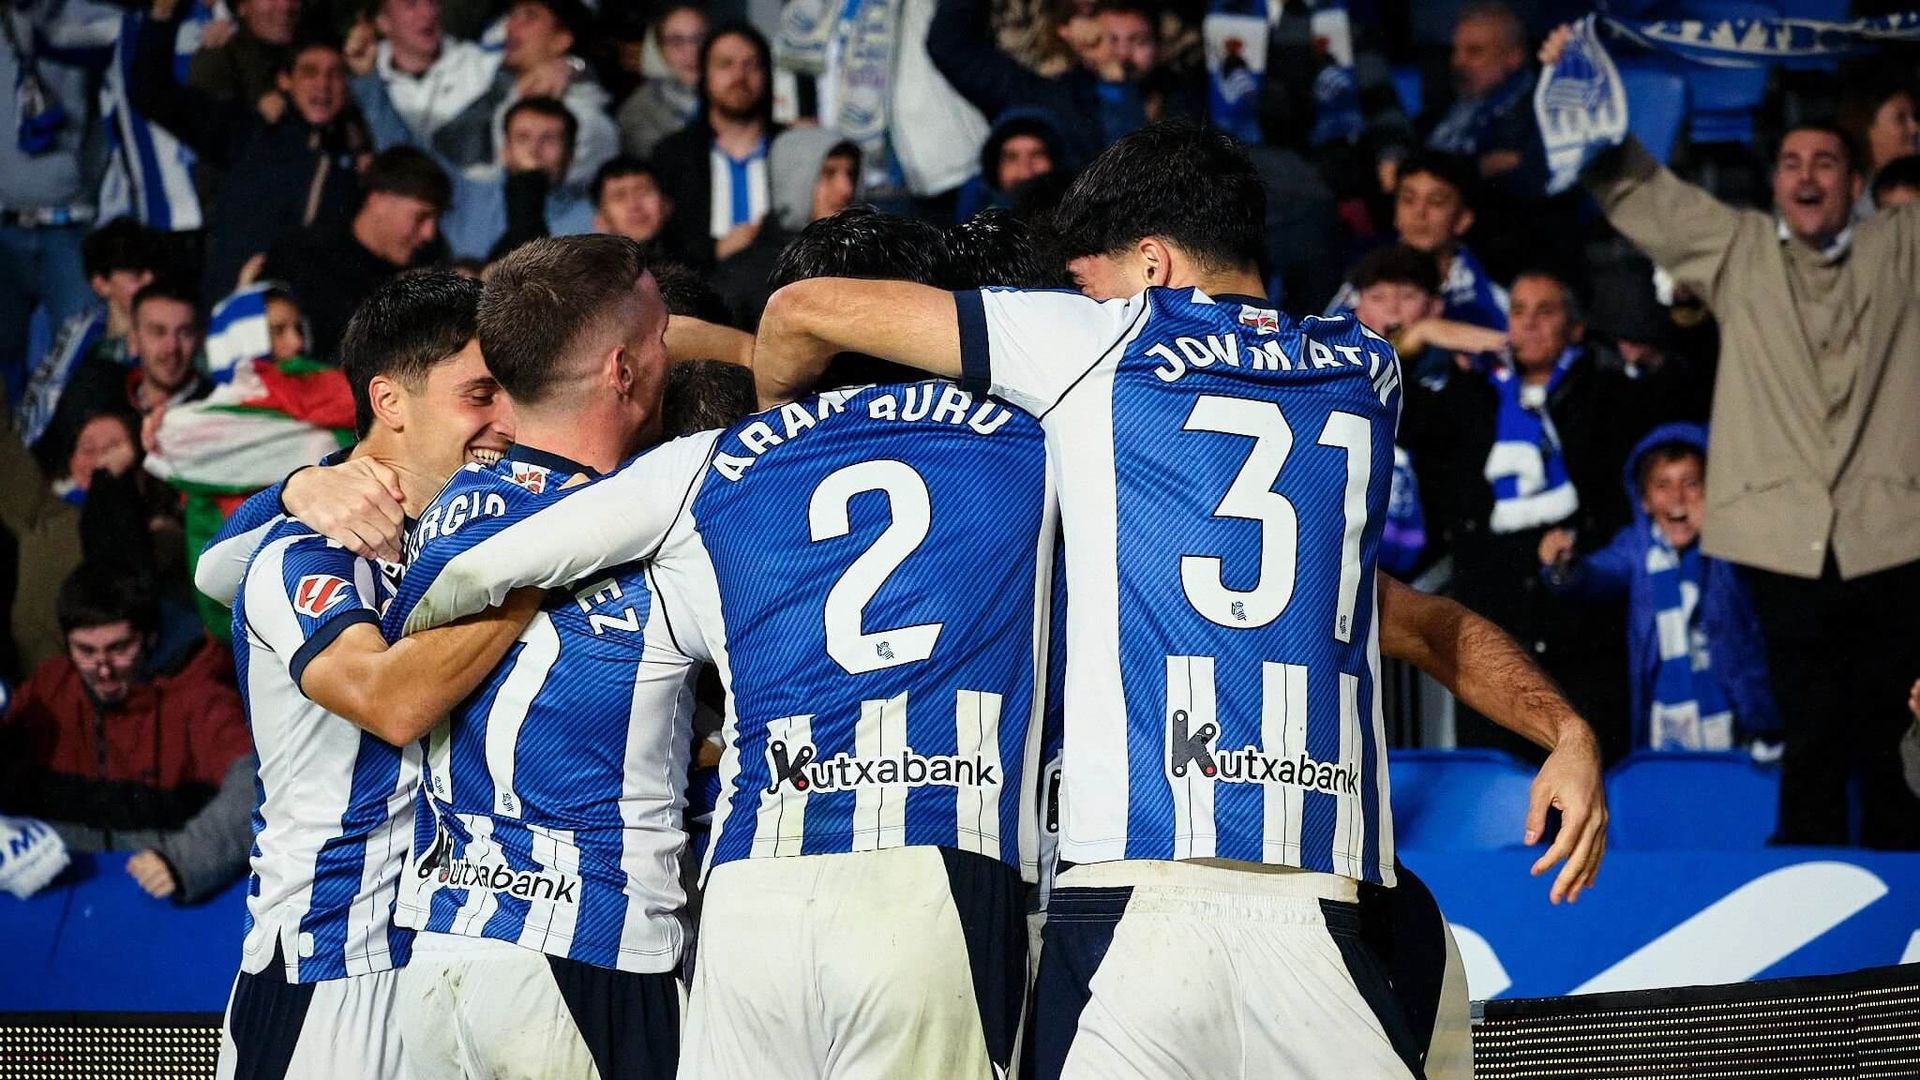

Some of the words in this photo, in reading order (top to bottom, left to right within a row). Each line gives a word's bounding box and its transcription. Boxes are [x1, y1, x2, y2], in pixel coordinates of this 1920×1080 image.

[1144, 333, 1240, 383] JON
[1179, 394, 1373, 645] 31
[807, 459, 945, 675] 2
[767, 740, 998, 795] Kutxabank
[1171, 709, 1359, 796] Kutxabank
